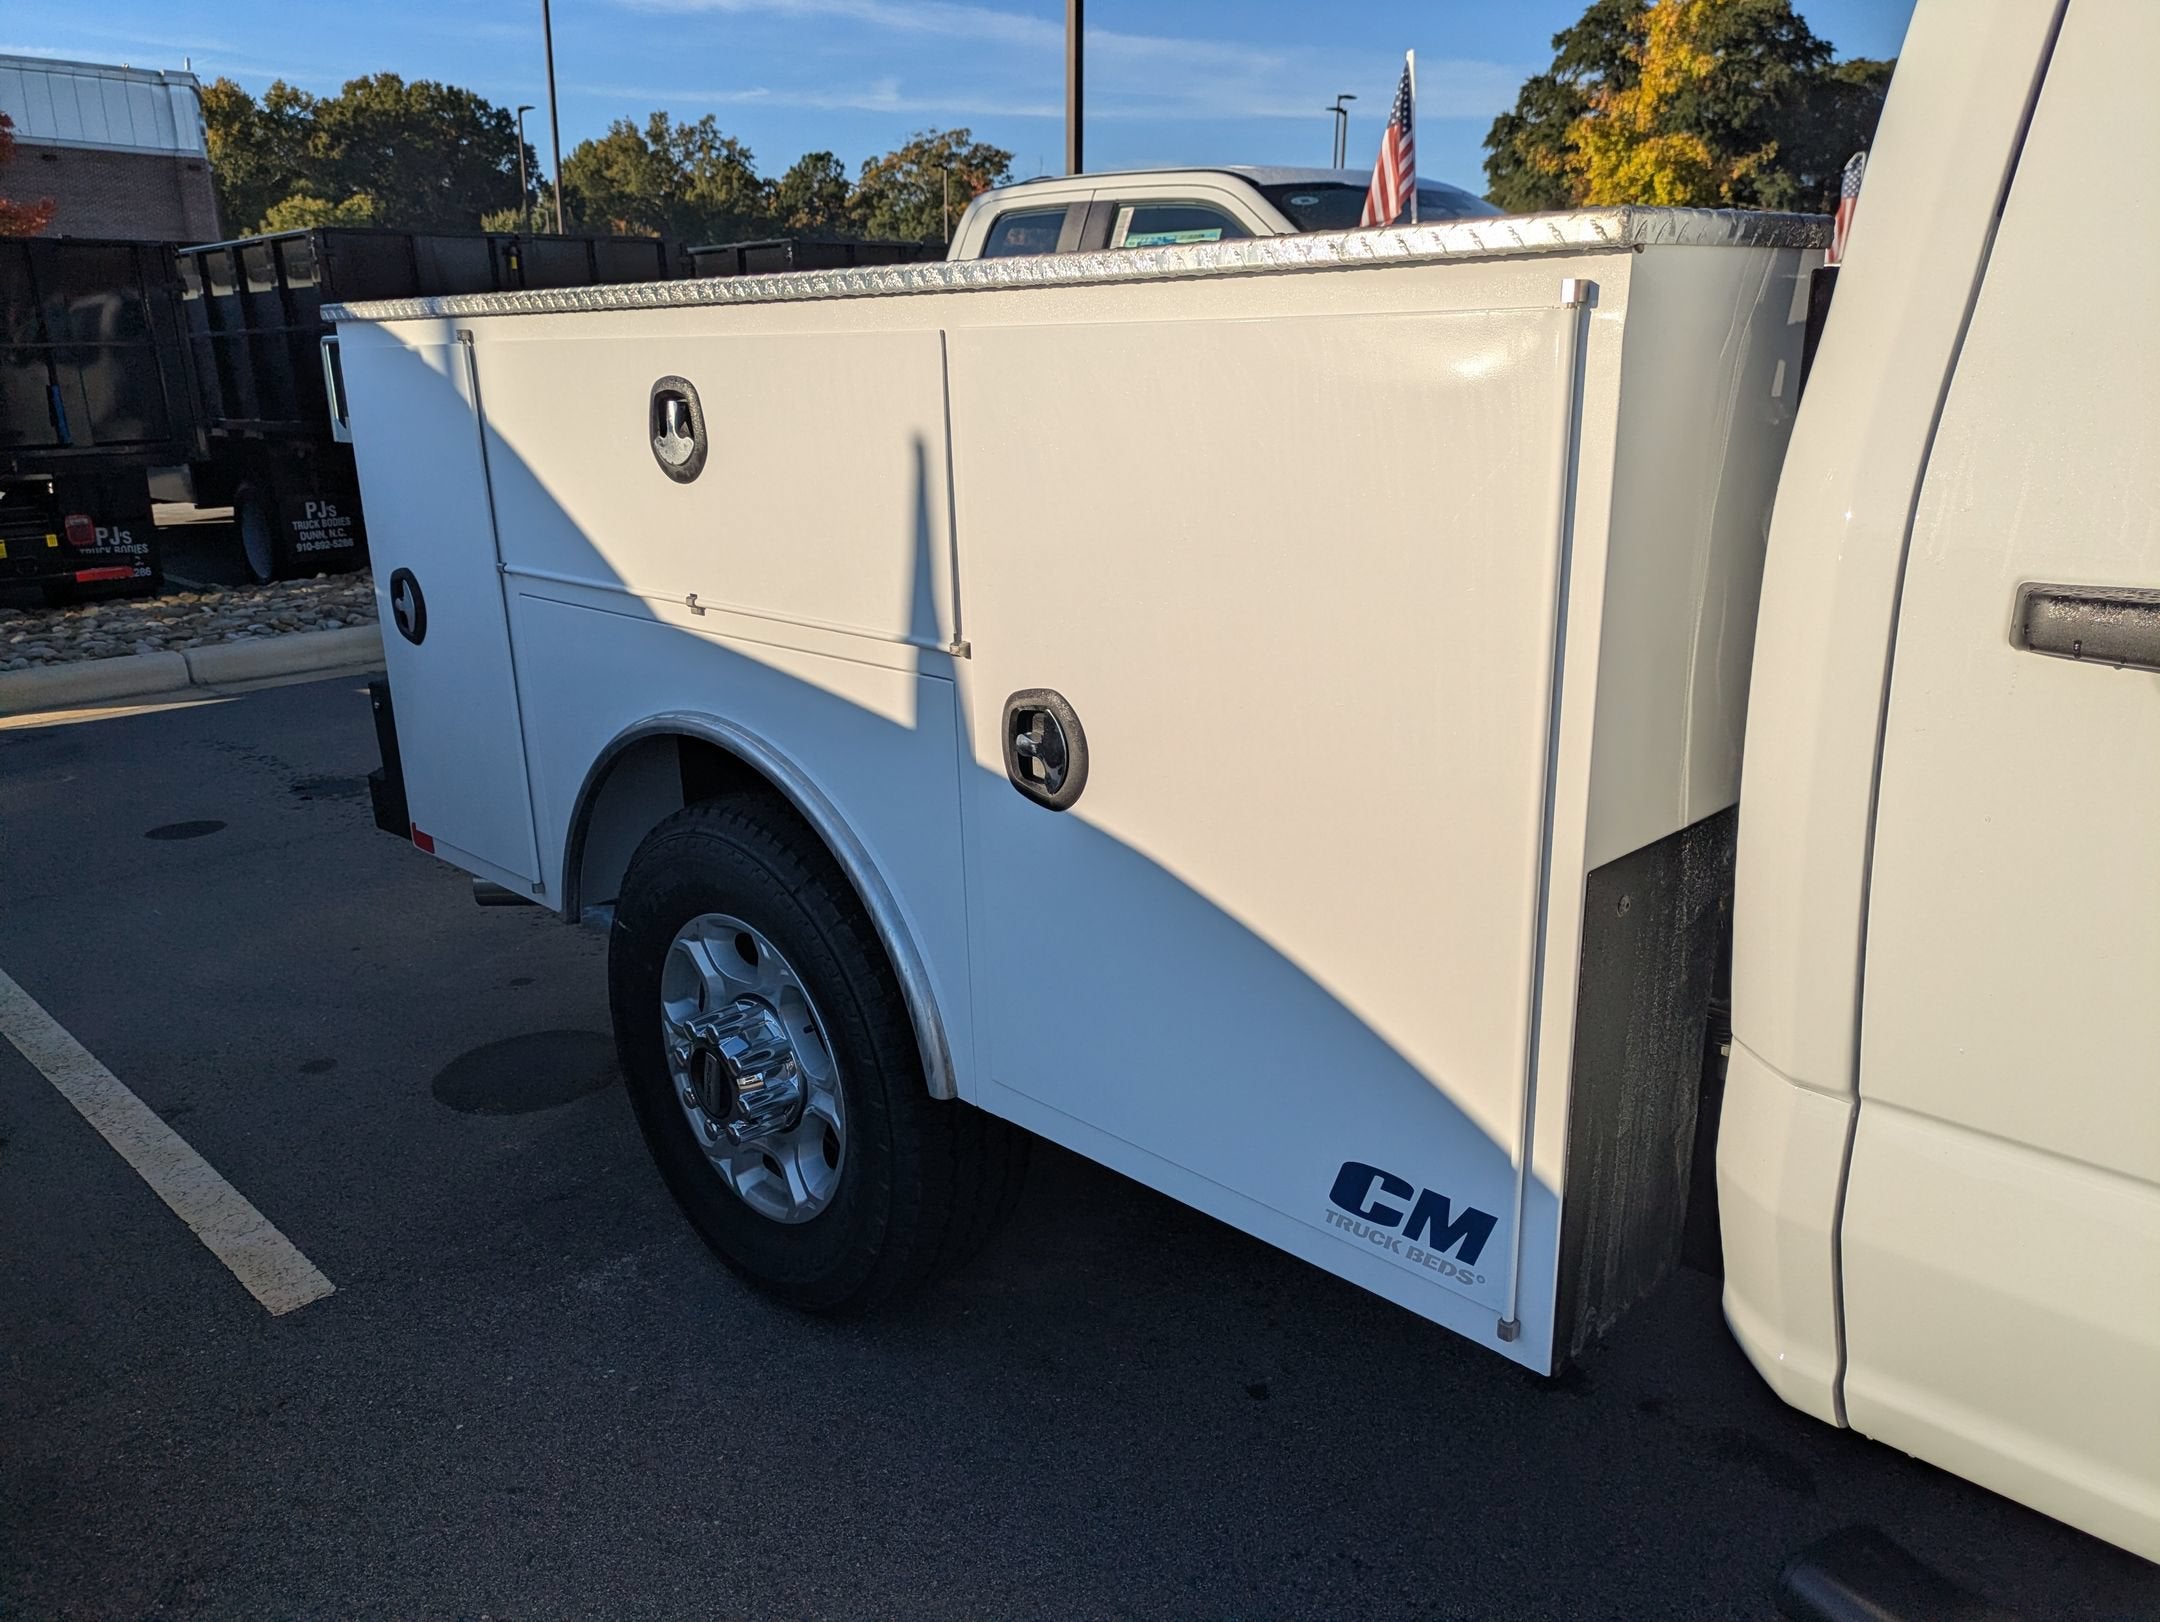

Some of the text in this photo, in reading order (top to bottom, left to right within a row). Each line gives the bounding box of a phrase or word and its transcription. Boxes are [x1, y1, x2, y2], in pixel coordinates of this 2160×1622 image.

[292, 516, 351, 531] TRUCK BODIES
[1325, 1208, 1402, 1255] TRUCK
[1329, 1161, 1498, 1266] CM
